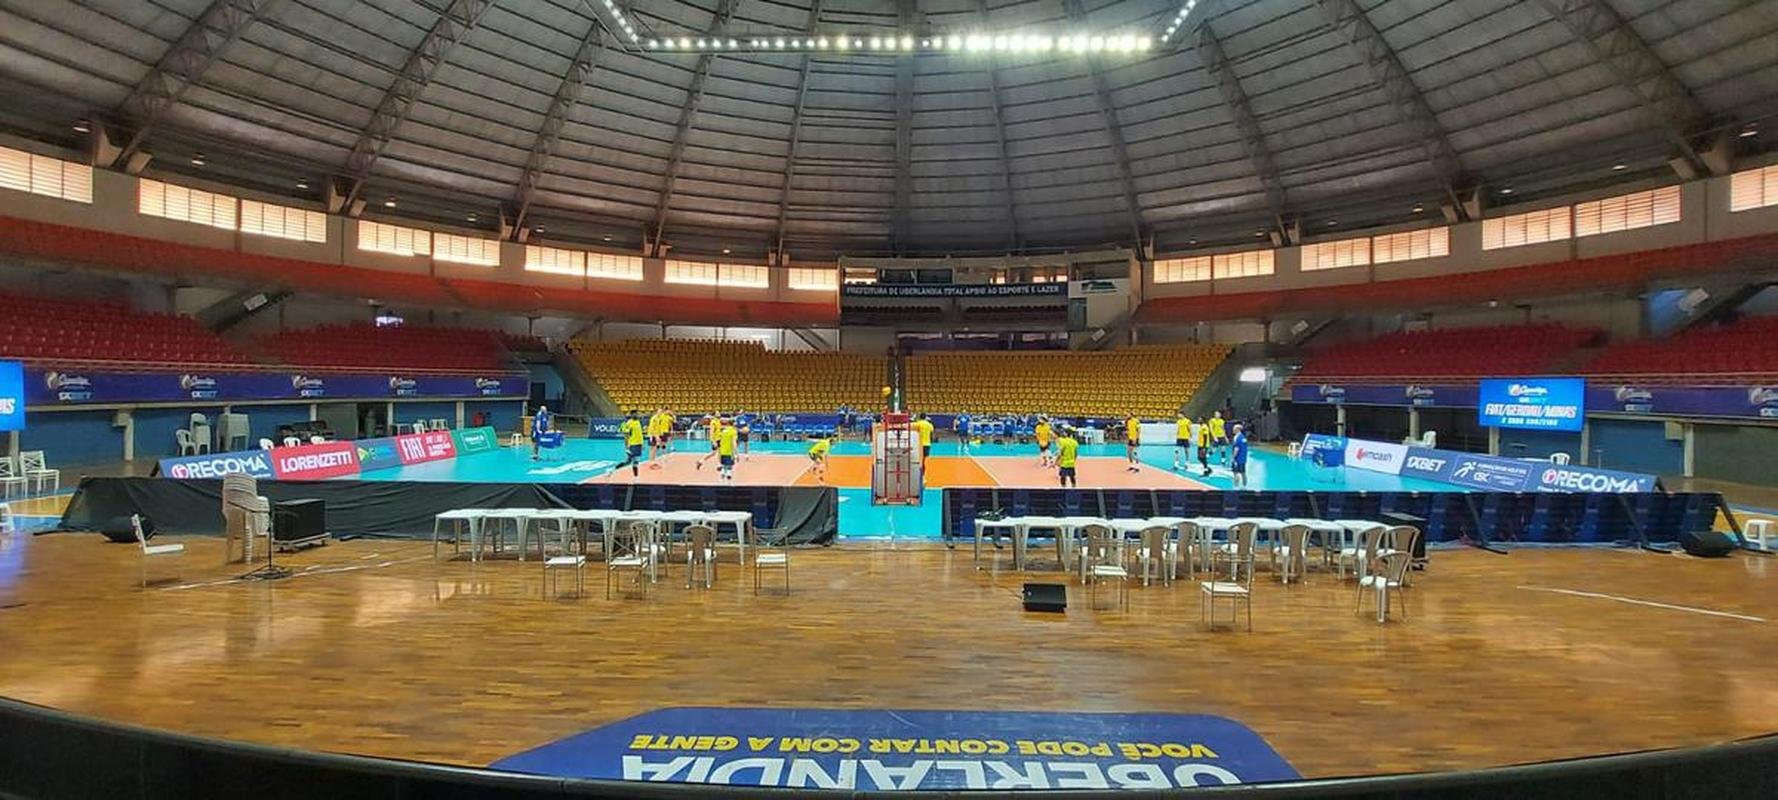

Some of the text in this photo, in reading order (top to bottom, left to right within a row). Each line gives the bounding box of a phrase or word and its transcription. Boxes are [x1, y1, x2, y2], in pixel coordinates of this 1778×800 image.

[400, 437, 426, 460] FIAT
[186, 457, 268, 479] RECOMA
[281, 451, 352, 473] LORENZETTI
[1406, 456, 1447, 472] 1XBET
[1554, 470, 1639, 493] RECOMA
[629, 734, 1219, 761] VOCÊ PODE CONTAR COM A GENTE
